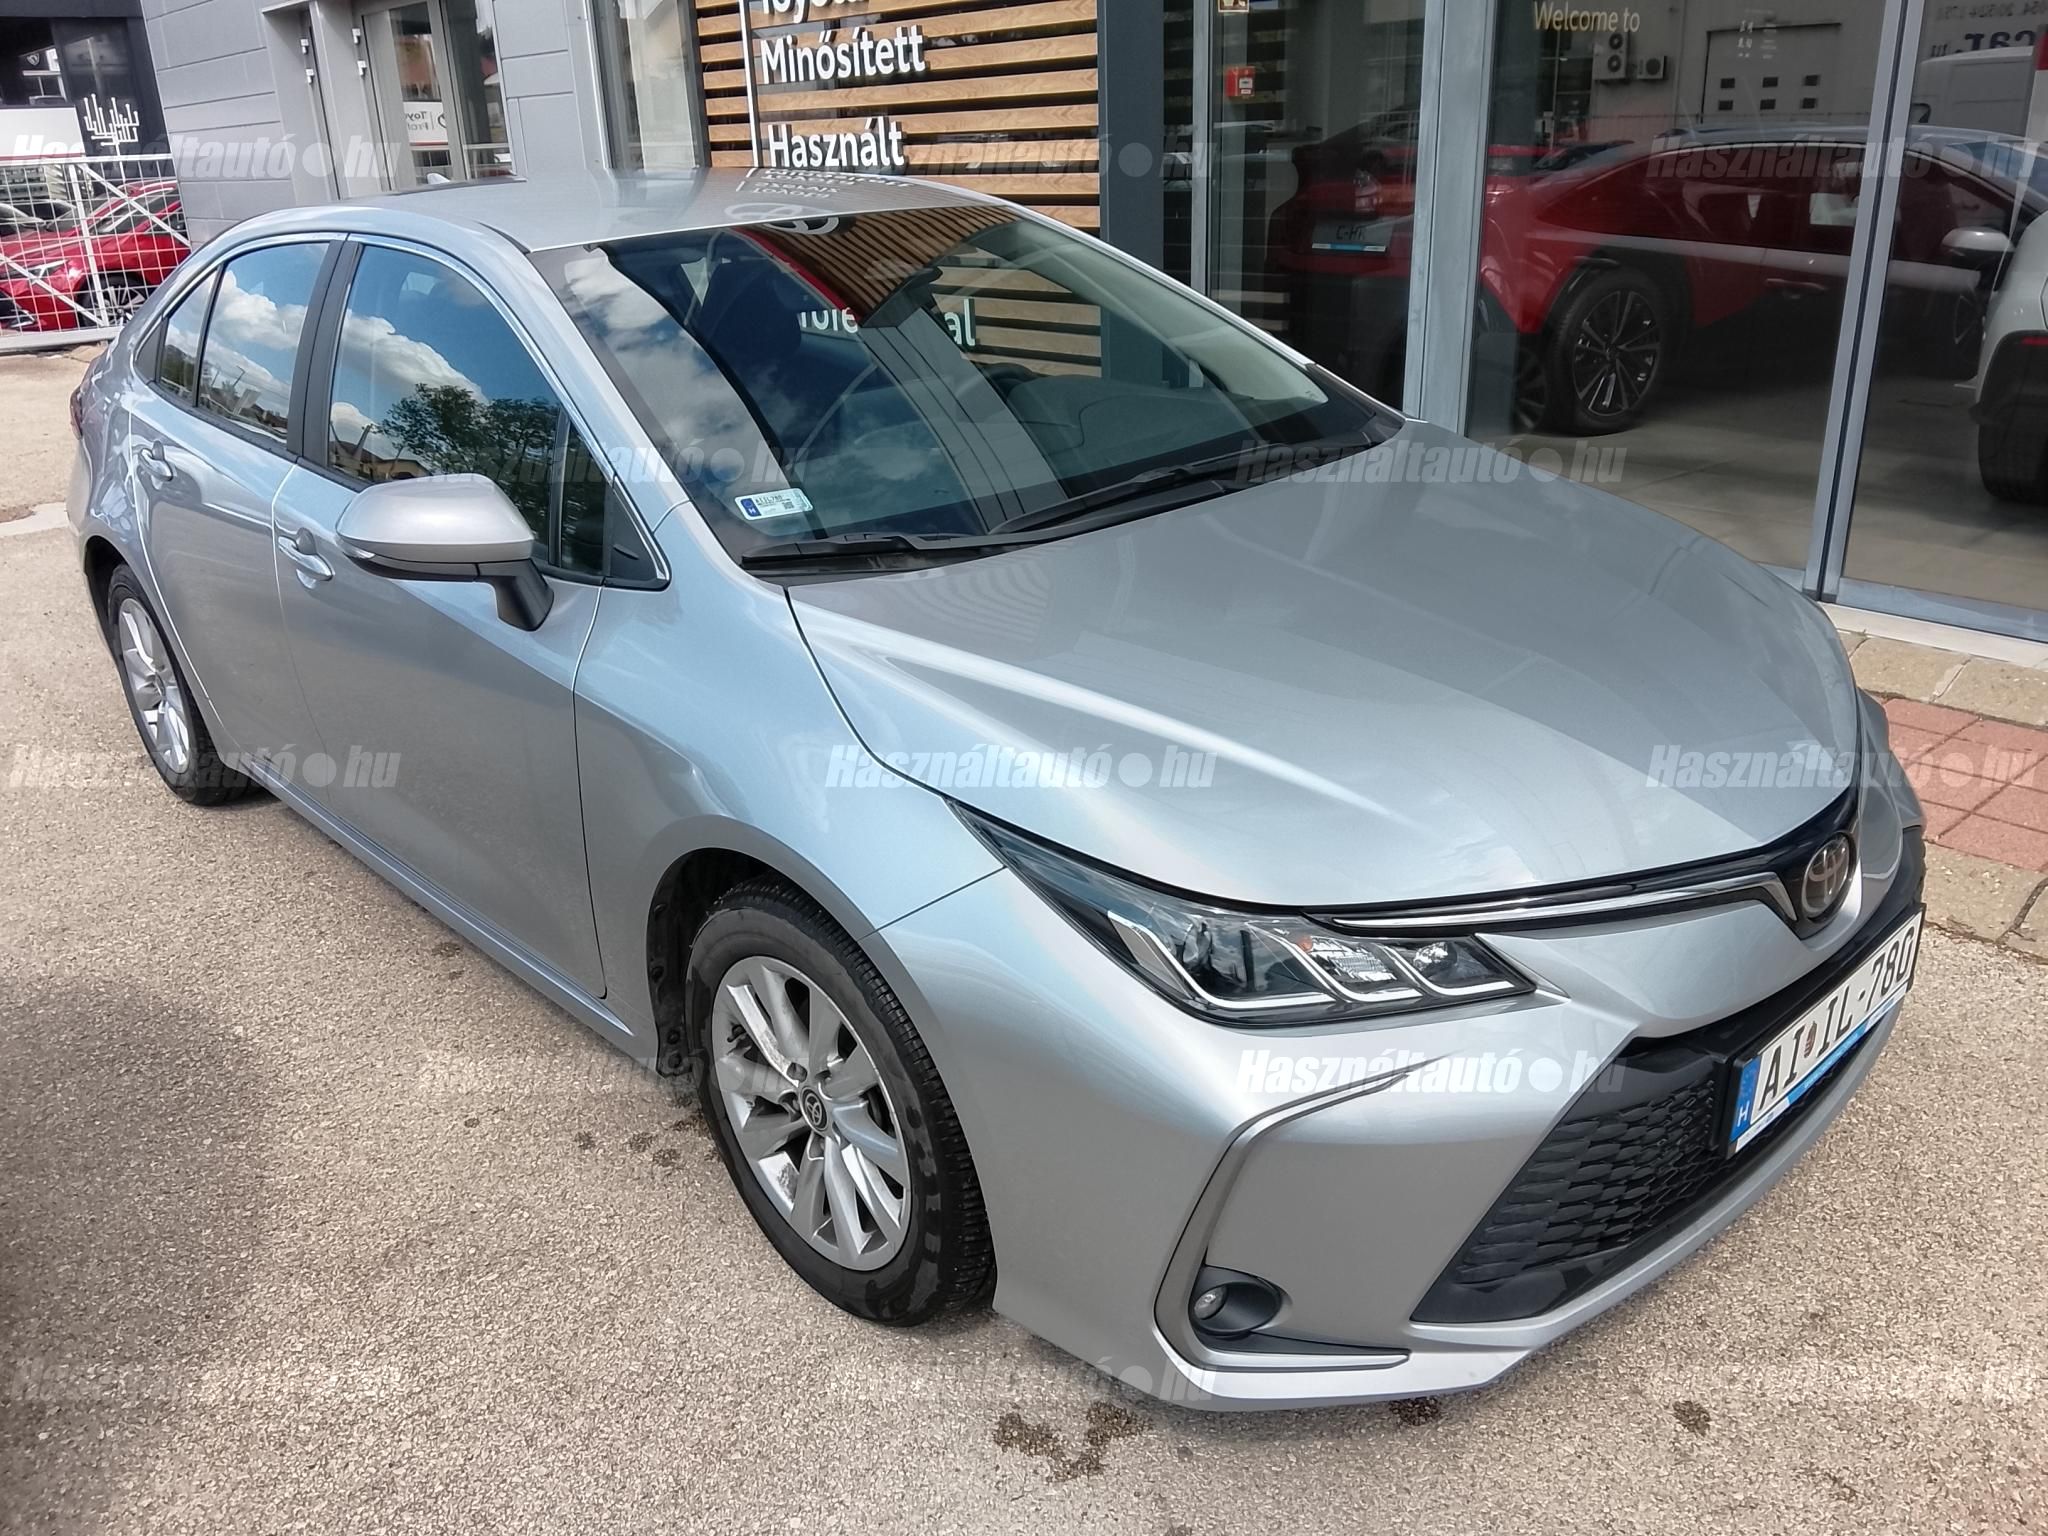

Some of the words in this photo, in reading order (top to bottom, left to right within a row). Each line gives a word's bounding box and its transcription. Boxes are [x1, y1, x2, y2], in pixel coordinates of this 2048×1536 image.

[1534, 1, 1619, 31] Welcome
[1623, 7, 1640, 32] to
[760, 25, 926, 85] Minősített
[767, 115, 905, 168] Használt
[1737, 1100, 1750, 1128] H
